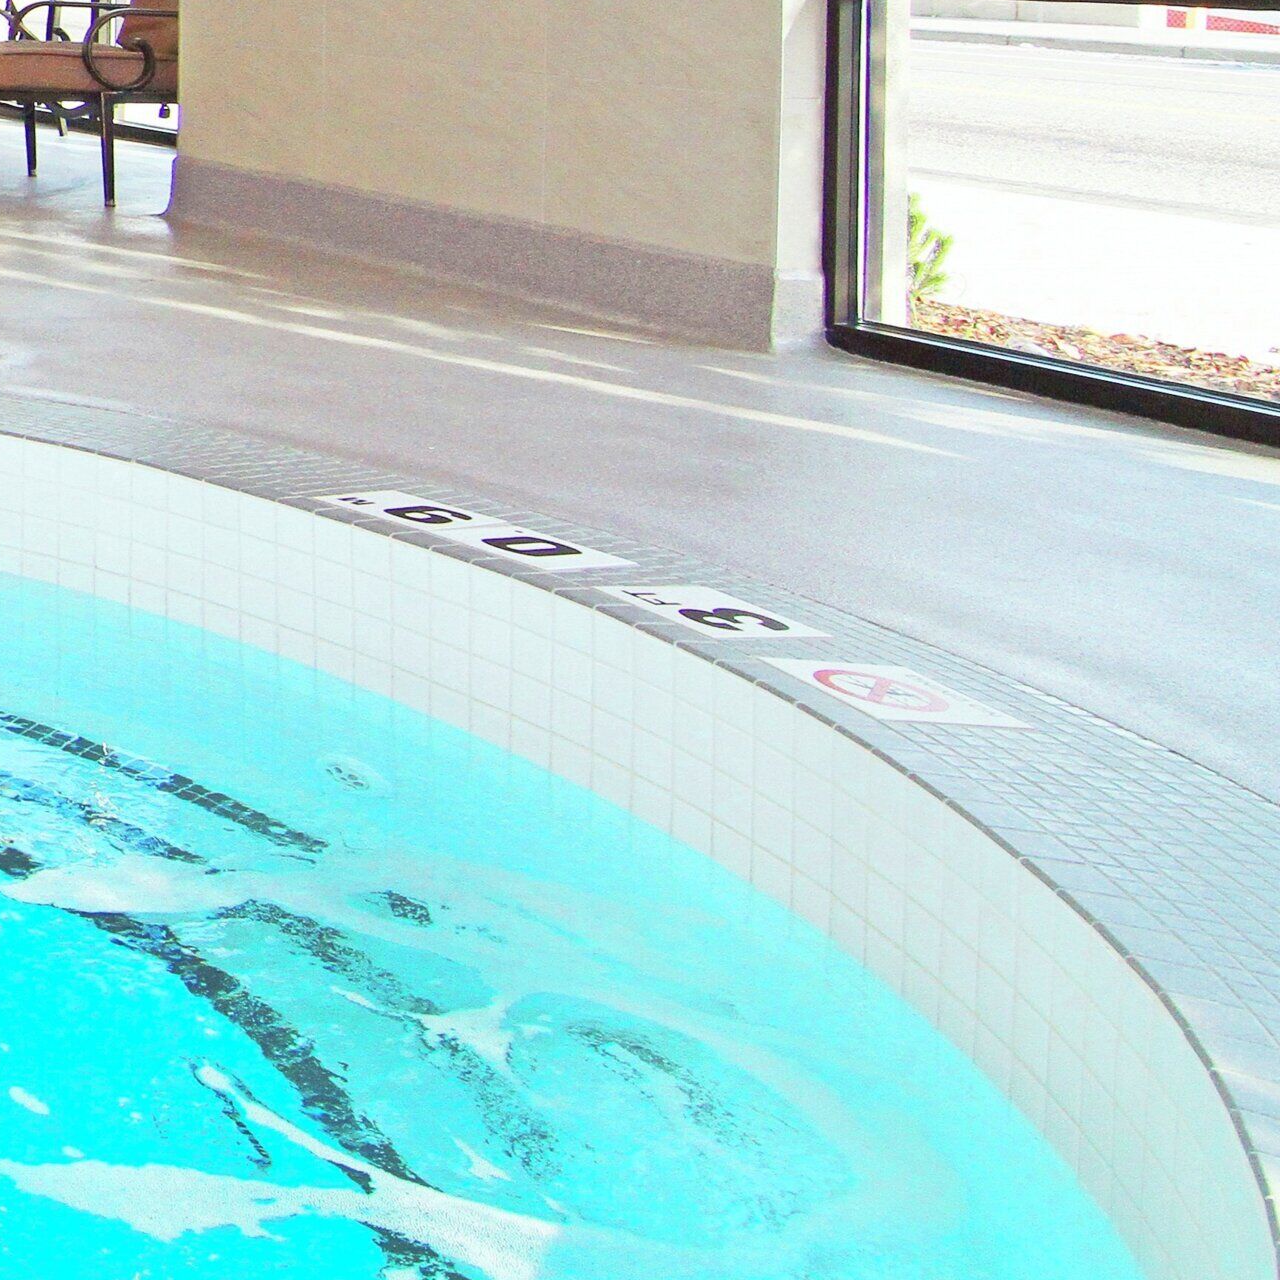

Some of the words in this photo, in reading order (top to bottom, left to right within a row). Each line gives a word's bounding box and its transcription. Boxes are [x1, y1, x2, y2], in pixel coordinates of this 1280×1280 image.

[337, 496, 375, 506] M
[621, 588, 682, 607] FT
[678, 607, 790, 632] 3
